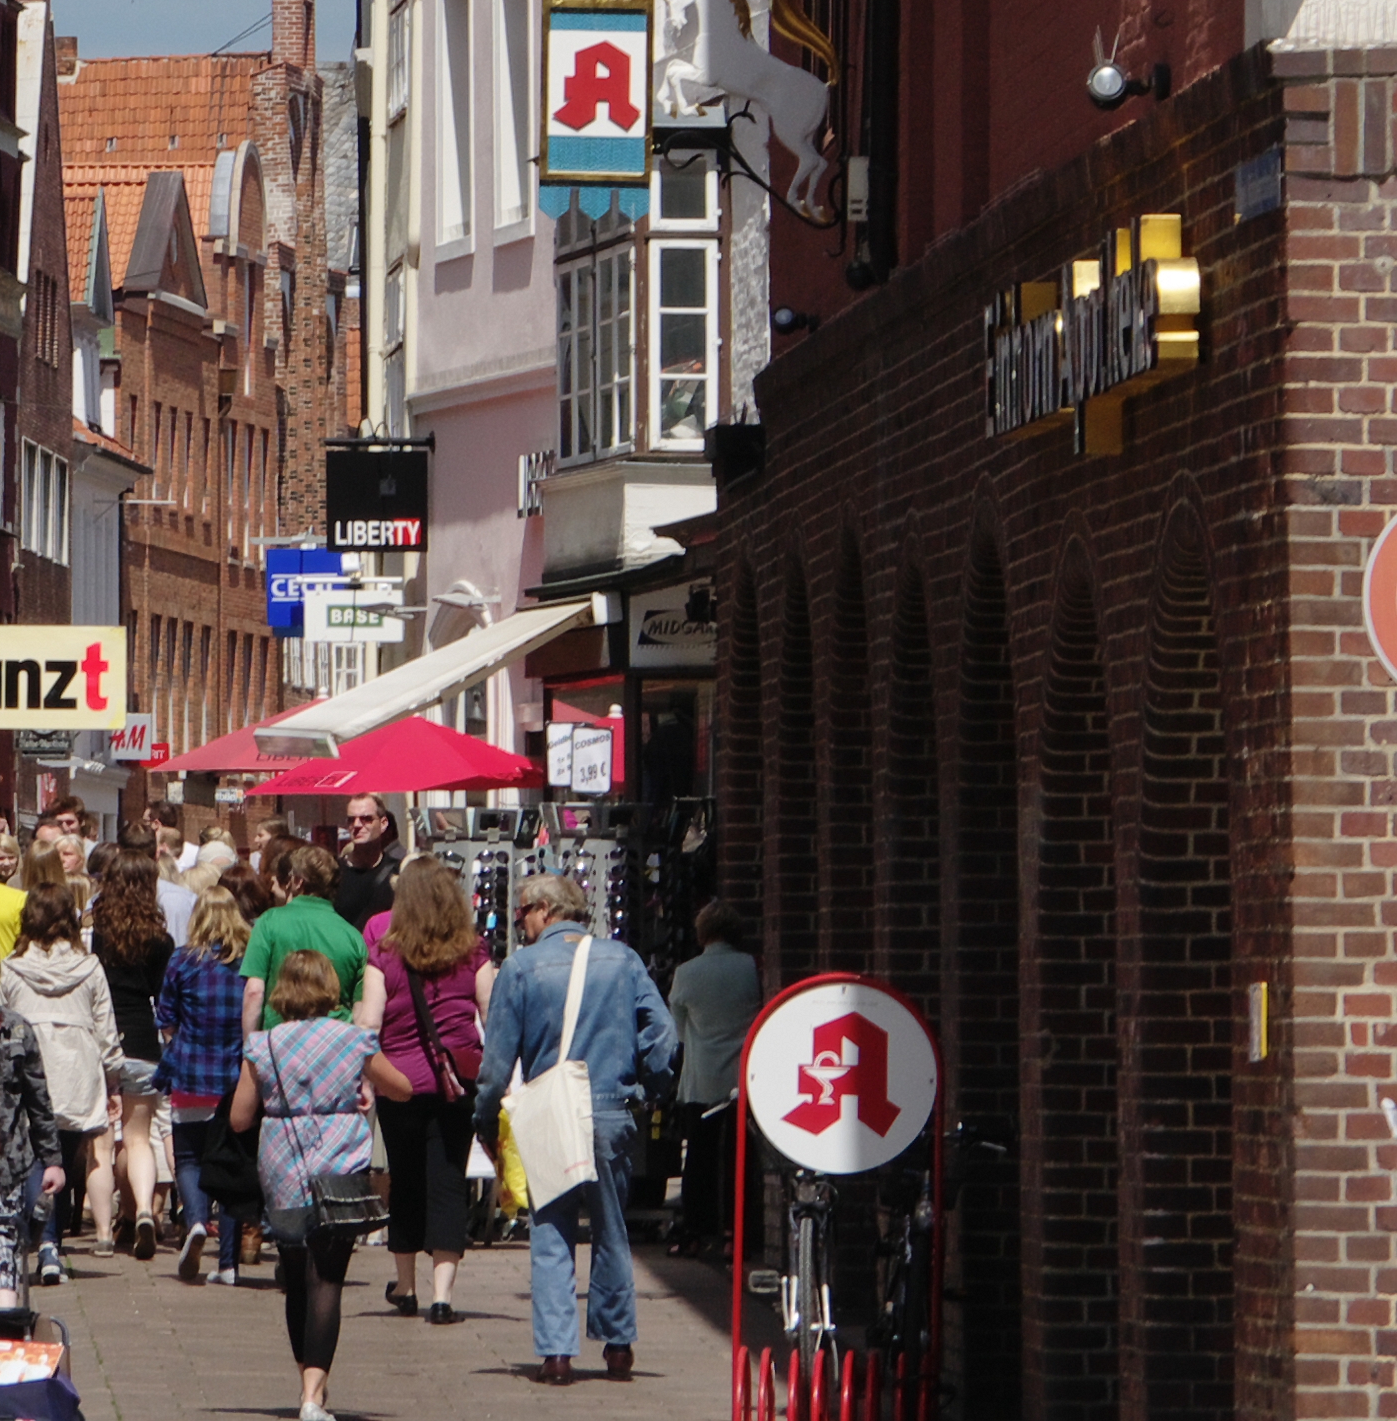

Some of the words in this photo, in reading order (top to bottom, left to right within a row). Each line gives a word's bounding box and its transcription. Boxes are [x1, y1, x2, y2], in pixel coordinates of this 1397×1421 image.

[335, 520, 421, 546] LIBERTY
[330, 608, 380, 624] BASE
[108, 724, 146, 751] H&M
[574, 733, 611, 750] COSMOS
